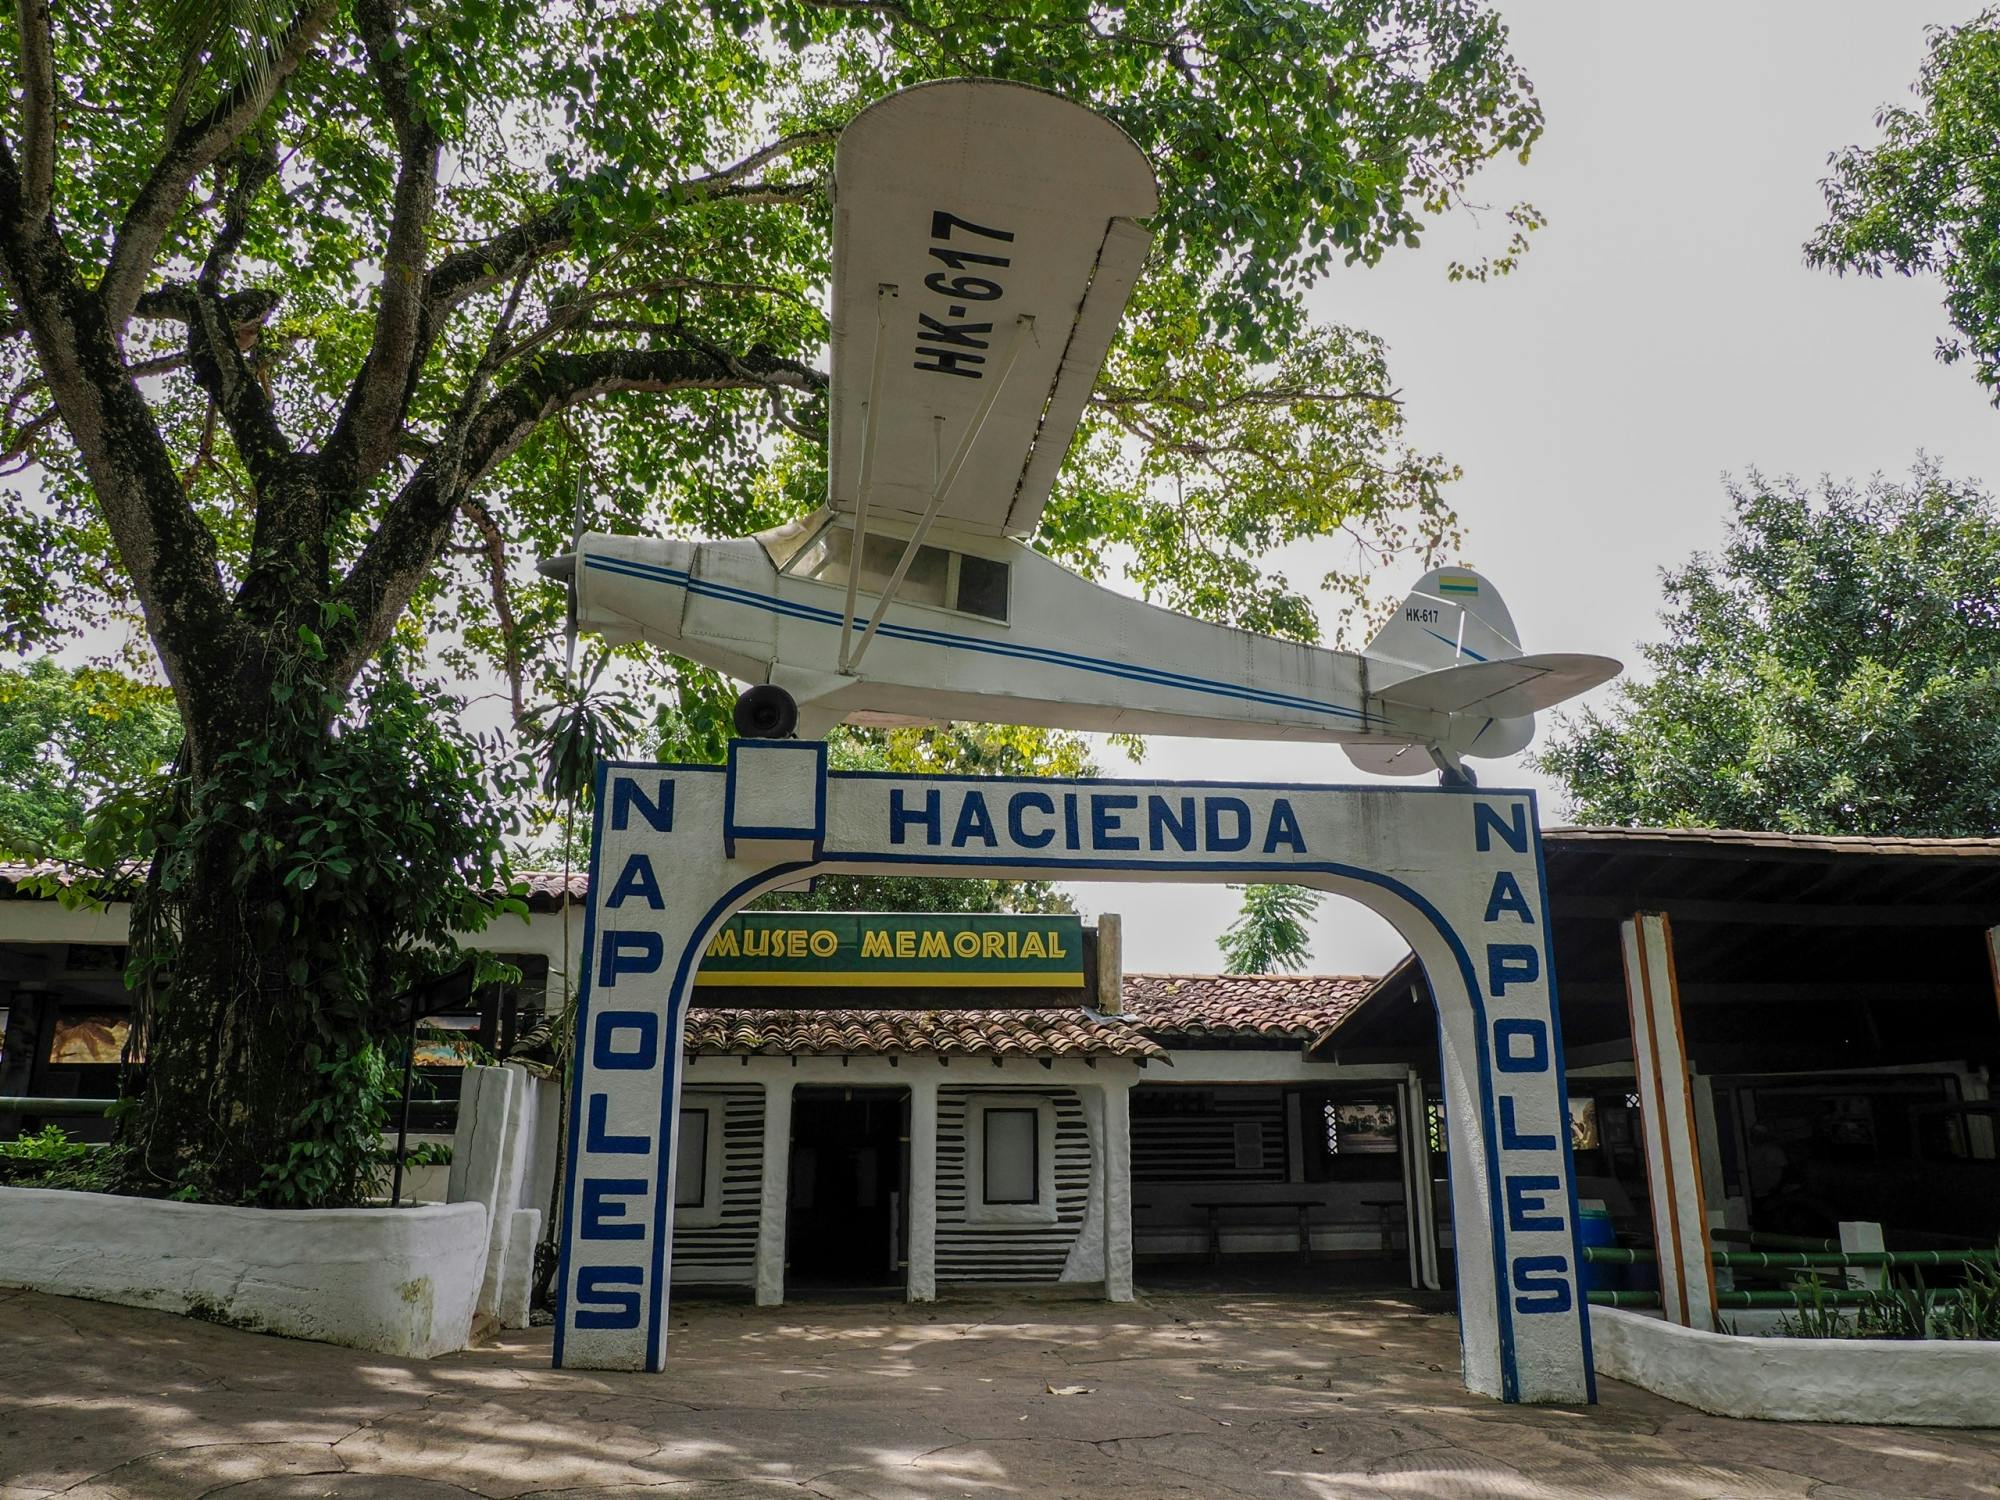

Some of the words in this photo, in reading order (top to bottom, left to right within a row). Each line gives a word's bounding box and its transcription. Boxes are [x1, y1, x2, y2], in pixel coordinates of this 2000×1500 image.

[913, 210, 1014, 379] HK-617
[1406, 608, 1438, 623] HK-617
[889, 788, 1308, 853] HACIENDA
[706, 929, 838, 957] MUSEO
[860, 931, 1067, 959] MEMORIAL
[575, 777, 675, 1330] NAPOLES
[1473, 801, 1572, 1315] NAPOLES
